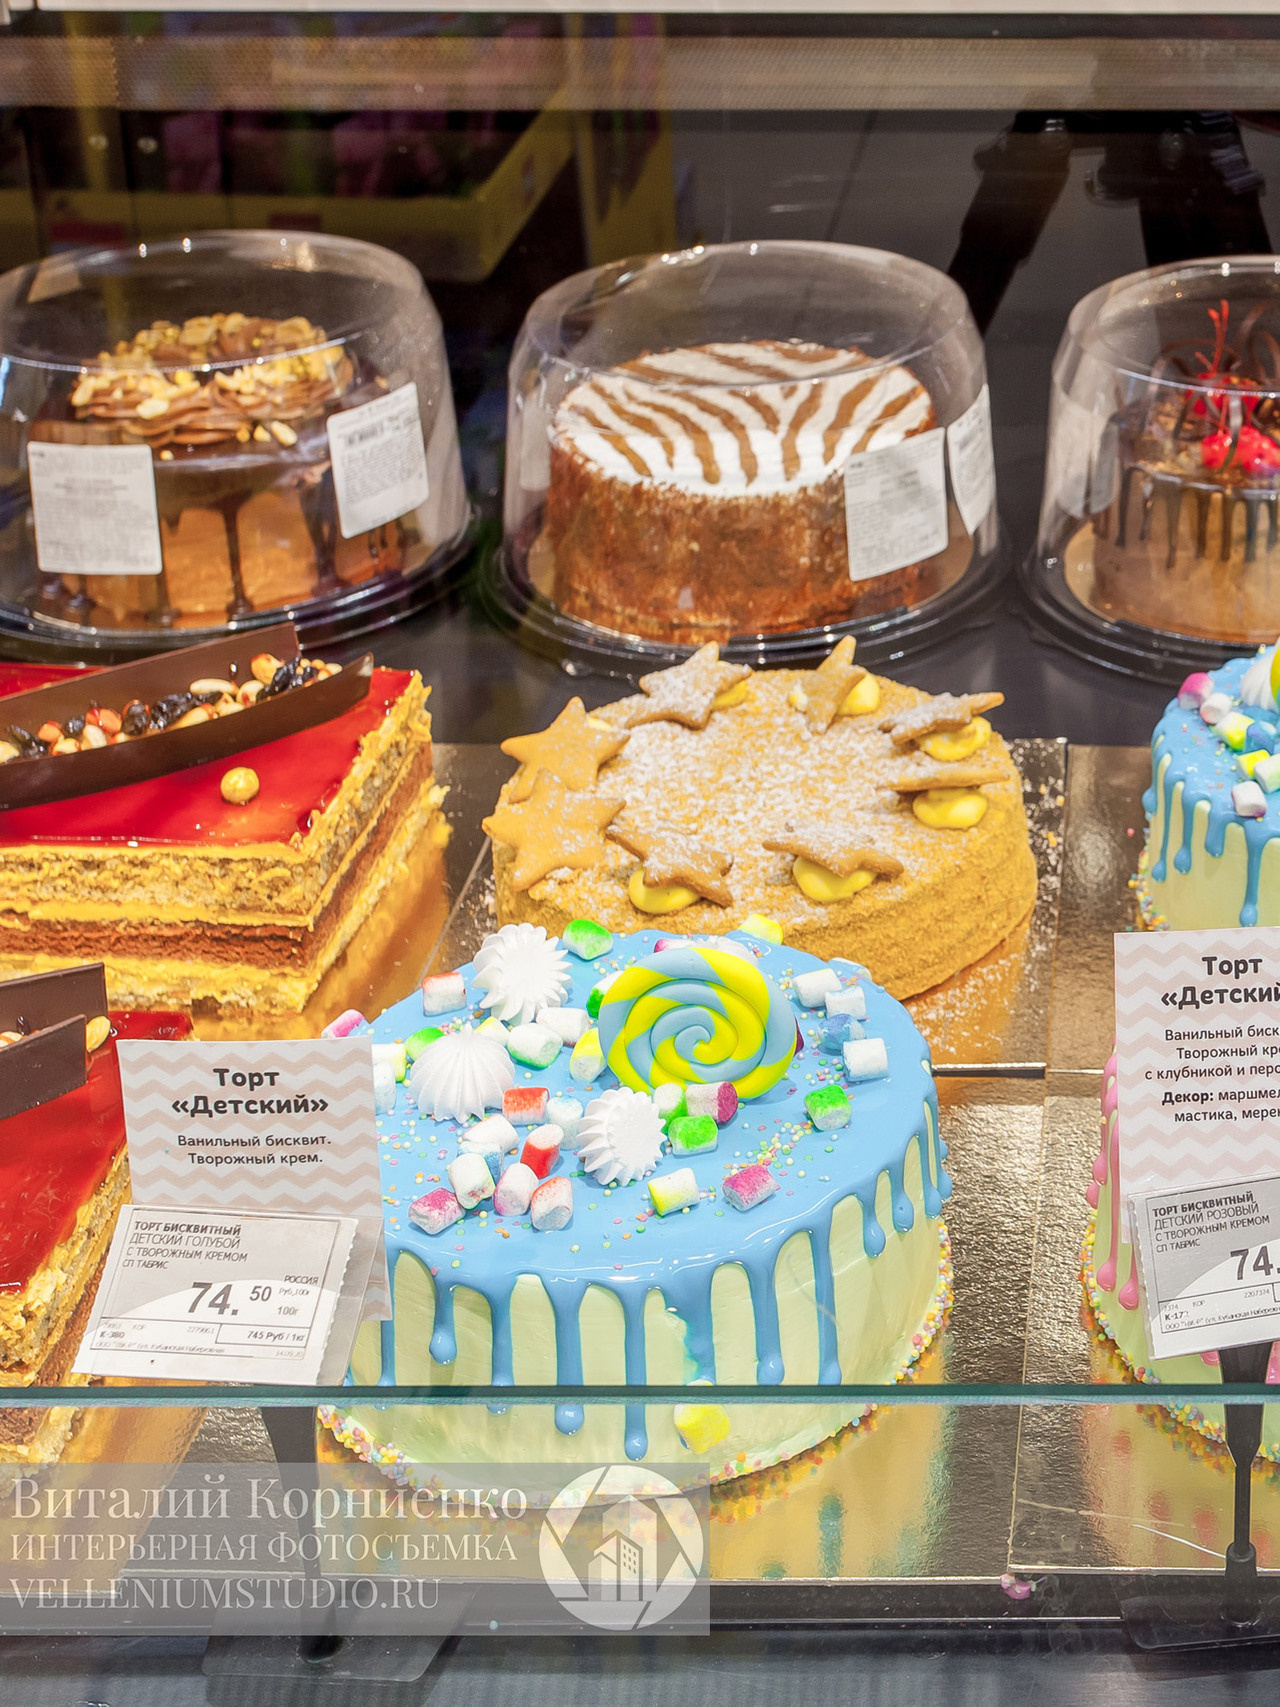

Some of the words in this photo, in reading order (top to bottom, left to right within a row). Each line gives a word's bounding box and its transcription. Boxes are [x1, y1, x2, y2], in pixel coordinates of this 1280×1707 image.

[1202, 956, 1262, 979] Торт
[1165, 1026, 1243, 1041] Ванильный
[1176, 1046, 1257, 1062] Творожный
[213, 1068, 279, 1091] Торт
[1145, 1070, 1152, 1080] с
[1157, 1065, 1232, 1082] клубникой
[1237, 1066, 1245, 1076] и
[172, 1094, 328, 1118] «Детский»
[1161, 1091, 1214, 1106] Декор:
[1174, 1108, 1237, 1122] мастика,
[178, 1135, 260, 1147] Ванильный
[265, 1135, 331, 1146] бисквит.
[188, 1153, 275, 1167] Творожный
[280, 1153, 323, 1166] крем.
[1152, 1205, 1179, 1218] ТОРТ
[1181, 1190, 1254, 1213] БИСКВИТНЫЙ
[1154, 1210, 1204, 1231] ДЕТСКИЙ
[1207, 1201, 1260, 1221] РОЗОВЫЙ
[135, 1221, 162, 1232] ТОРТ
[163, 1222, 242, 1236] БИСКВИТНЫЙ
[1155, 1233, 1162, 1242] С
[1164, 1222, 1228, 1241] ТВОРОЖНЫМ
[1230, 1215, 1270, 1230] КРЕМОМ
[129, 1232, 183, 1245] ДЕТСКИЙ
[185, 1236, 241, 1249] ГОЛУБОЙ
[1156, 1245, 1168, 1253] СП
[1170, 1238, 1201, 1251] ТАБРИС
[127, 1247, 134, 1256] С
[136, 1247, 203, 1259] ТВОРОЖНЫМ
[205, 1251, 249, 1262] КРЕМОМ
[137, 1260, 169, 1270] ТАБРИС
[284, 1275, 319, 1285] РОССИЯ
[249, 1285, 272, 1302] 50
[278, 1306, 300, 1316] 100г
[247, 1331, 264, 1340] 745
[266, 1331, 285, 1342] Руб
